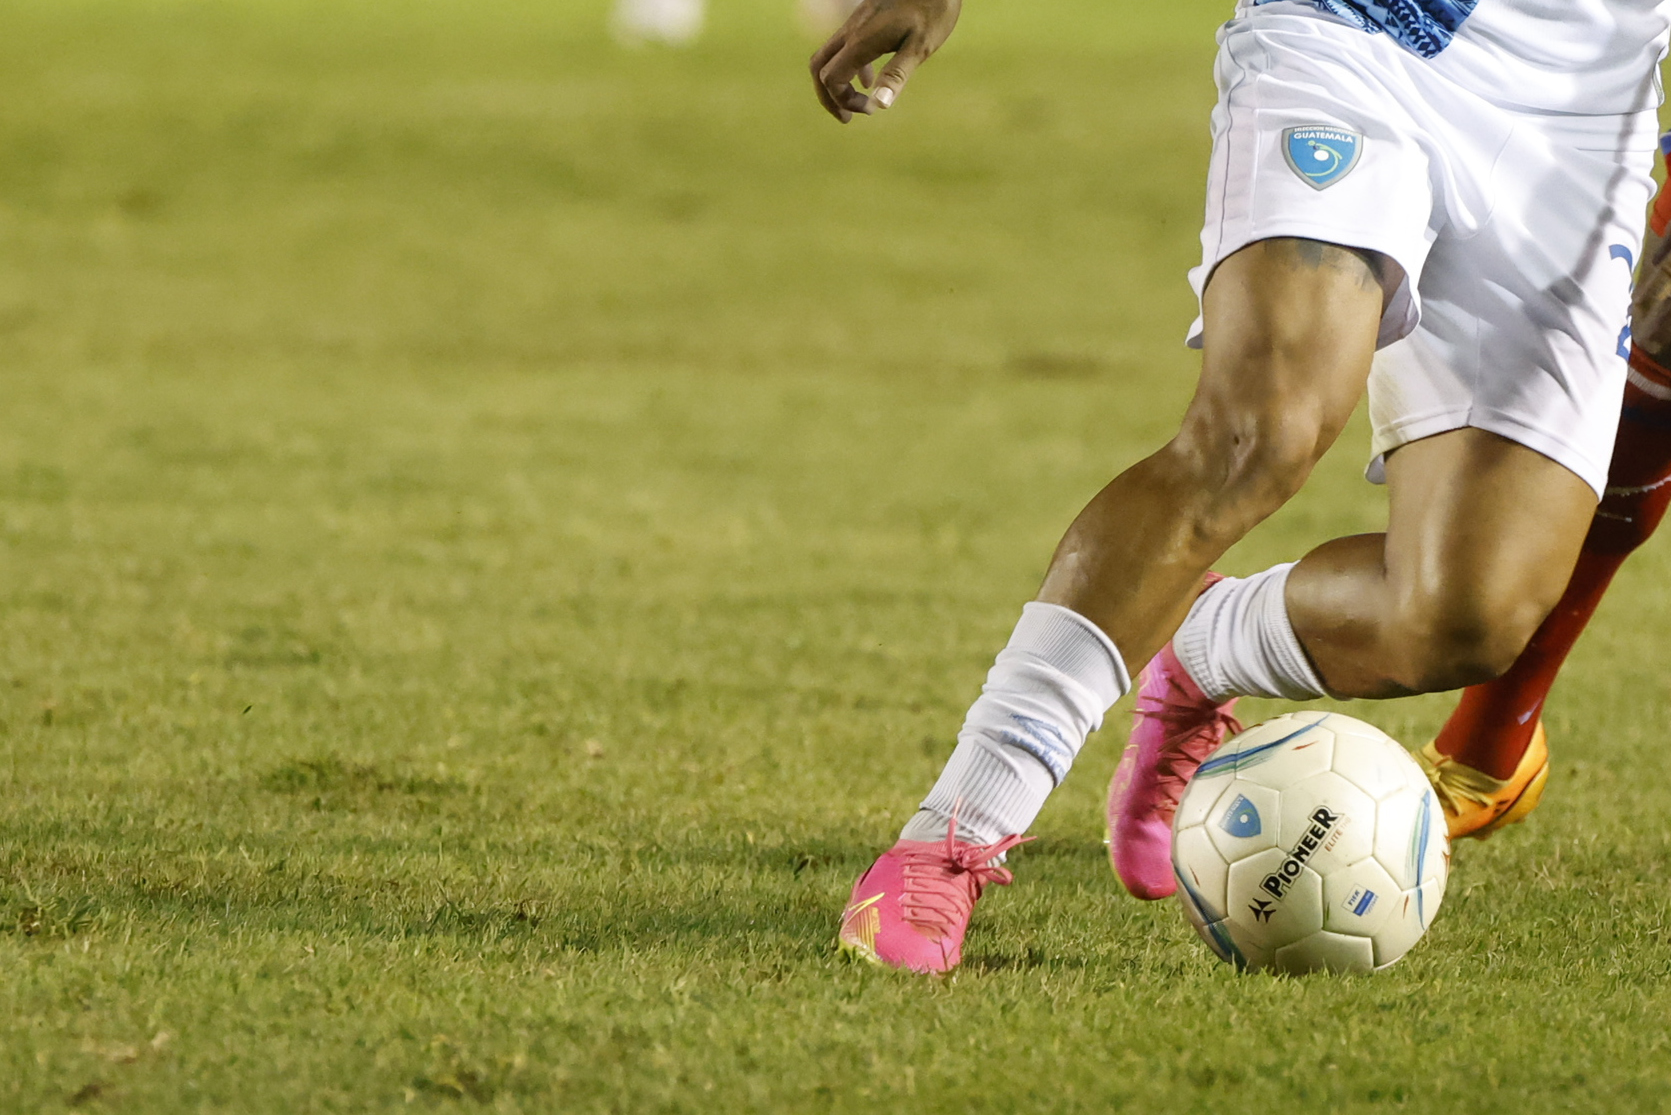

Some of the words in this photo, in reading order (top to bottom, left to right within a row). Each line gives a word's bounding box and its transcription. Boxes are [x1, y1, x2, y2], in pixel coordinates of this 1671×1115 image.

[1293, 131, 1353, 143] GUATEMALA
[1324, 829, 1342, 852] ELITE
[1263, 808, 1338, 898] PIONEER
